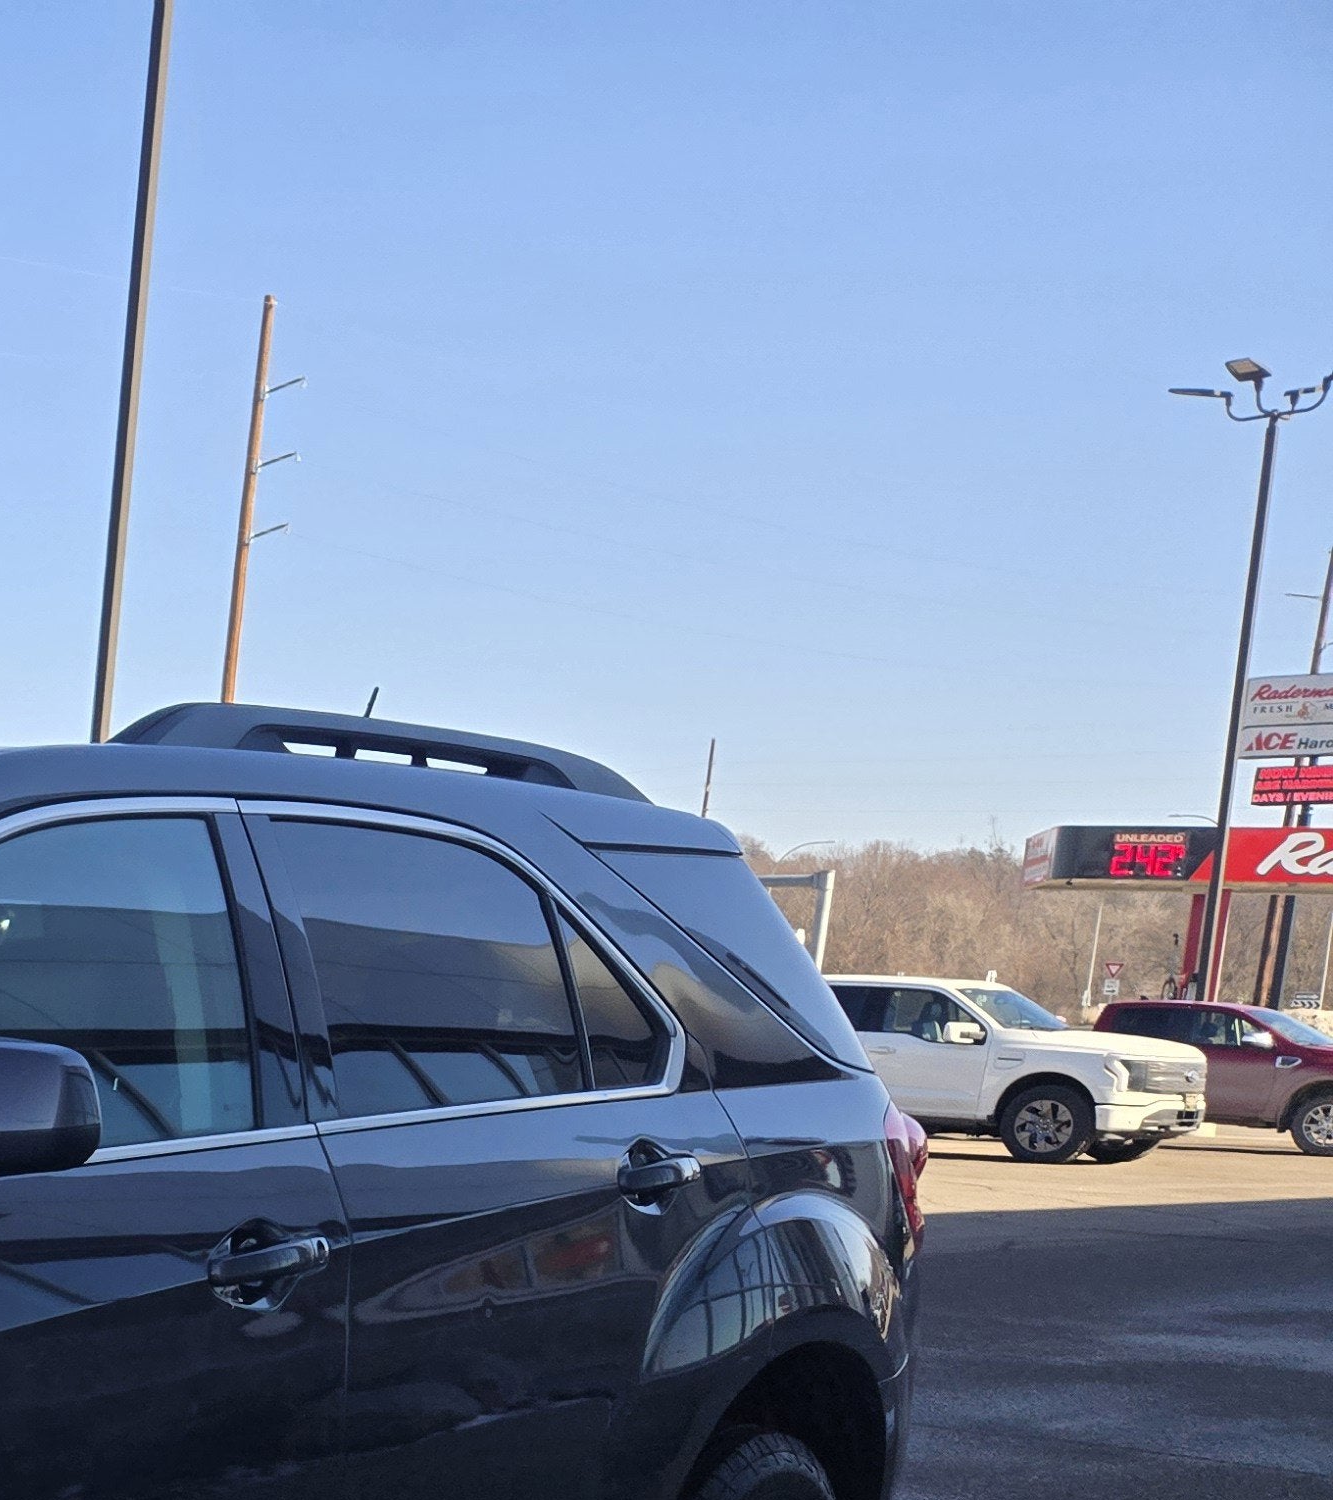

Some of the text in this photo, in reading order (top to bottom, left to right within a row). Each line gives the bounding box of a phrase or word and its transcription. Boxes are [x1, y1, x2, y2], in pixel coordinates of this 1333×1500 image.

[1253, 704, 1293, 714] FRESH
[1245, 731, 1298, 751] ACE
[1116, 834, 1184, 843] UNLEADED
